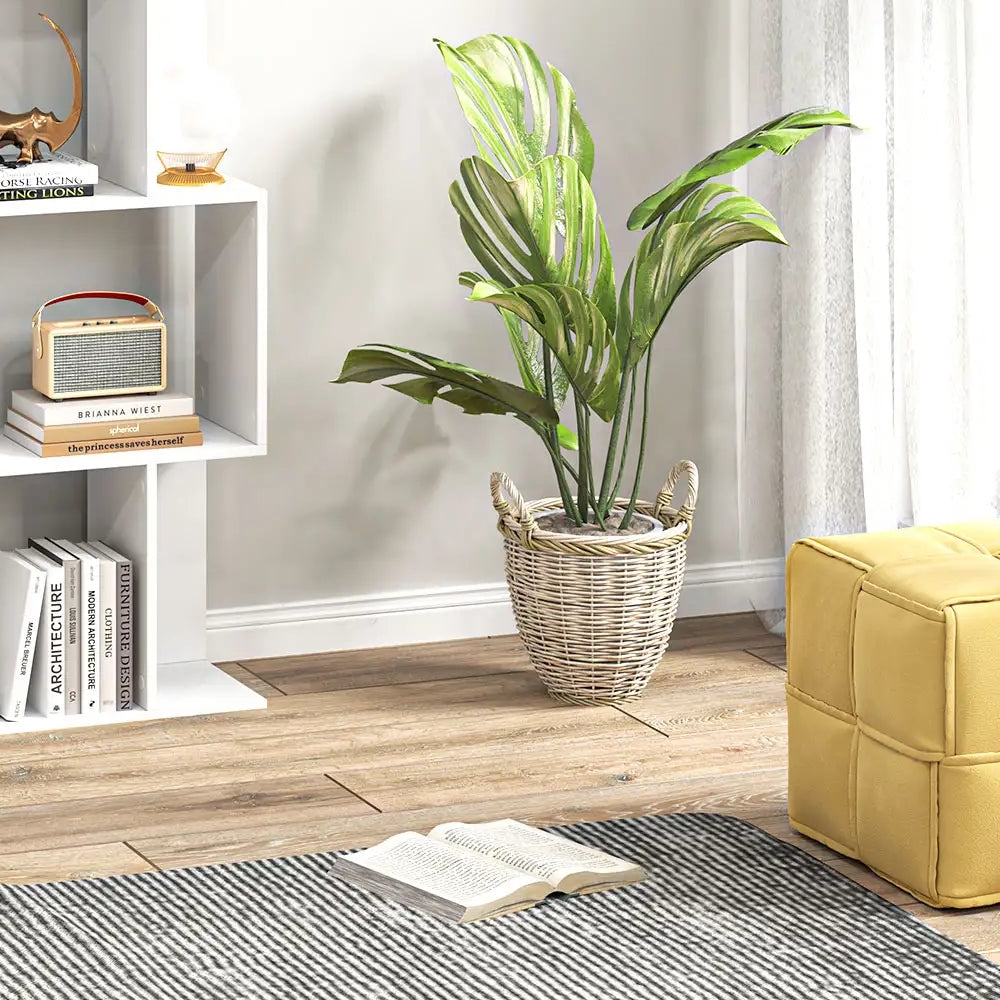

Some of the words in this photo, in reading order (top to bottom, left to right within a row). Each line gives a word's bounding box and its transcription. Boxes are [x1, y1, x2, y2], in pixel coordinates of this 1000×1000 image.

[36, 176, 83, 186] RACING
[42, 186, 84, 198] LIONS
[78, 408, 126, 419] BRIANNA
[130, 405, 162, 414] WIEST
[87, 590, 96, 626] MODERN
[120, 564, 130, 651] FURNITURE
[24, 621, 34, 648] MARCEL
[51, 583, 62, 694] ARCHITECTURE
[104, 607, 113, 658] CLOTHING
[19, 649, 30, 676] BREUER
[87, 627, 96, 690] ARCHITECTURE
[120, 655, 130, 710] DESIGN
